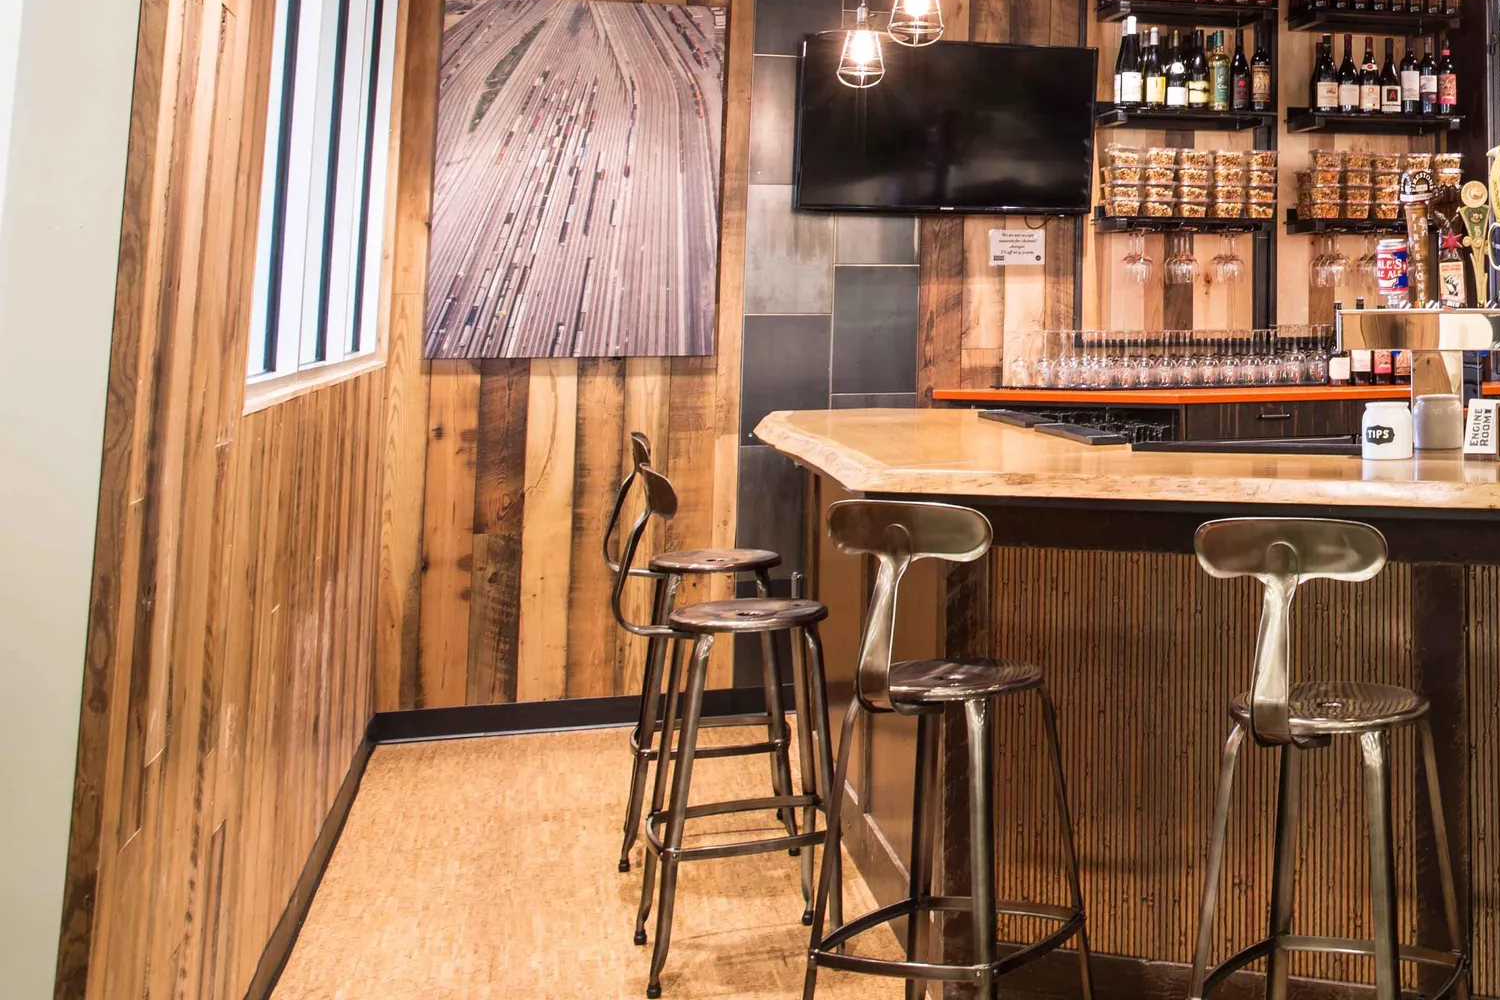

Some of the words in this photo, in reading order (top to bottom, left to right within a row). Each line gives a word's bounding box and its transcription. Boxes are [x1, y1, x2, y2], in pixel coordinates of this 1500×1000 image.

[1376, 258, 1402, 270] ALE'S
[1411, 213, 1426, 301] FIRESTONE
[1366, 428, 1390, 439] TIPS
[1469, 408, 1483, 446] ENGINE
[1479, 415, 1492, 447] ROOM
